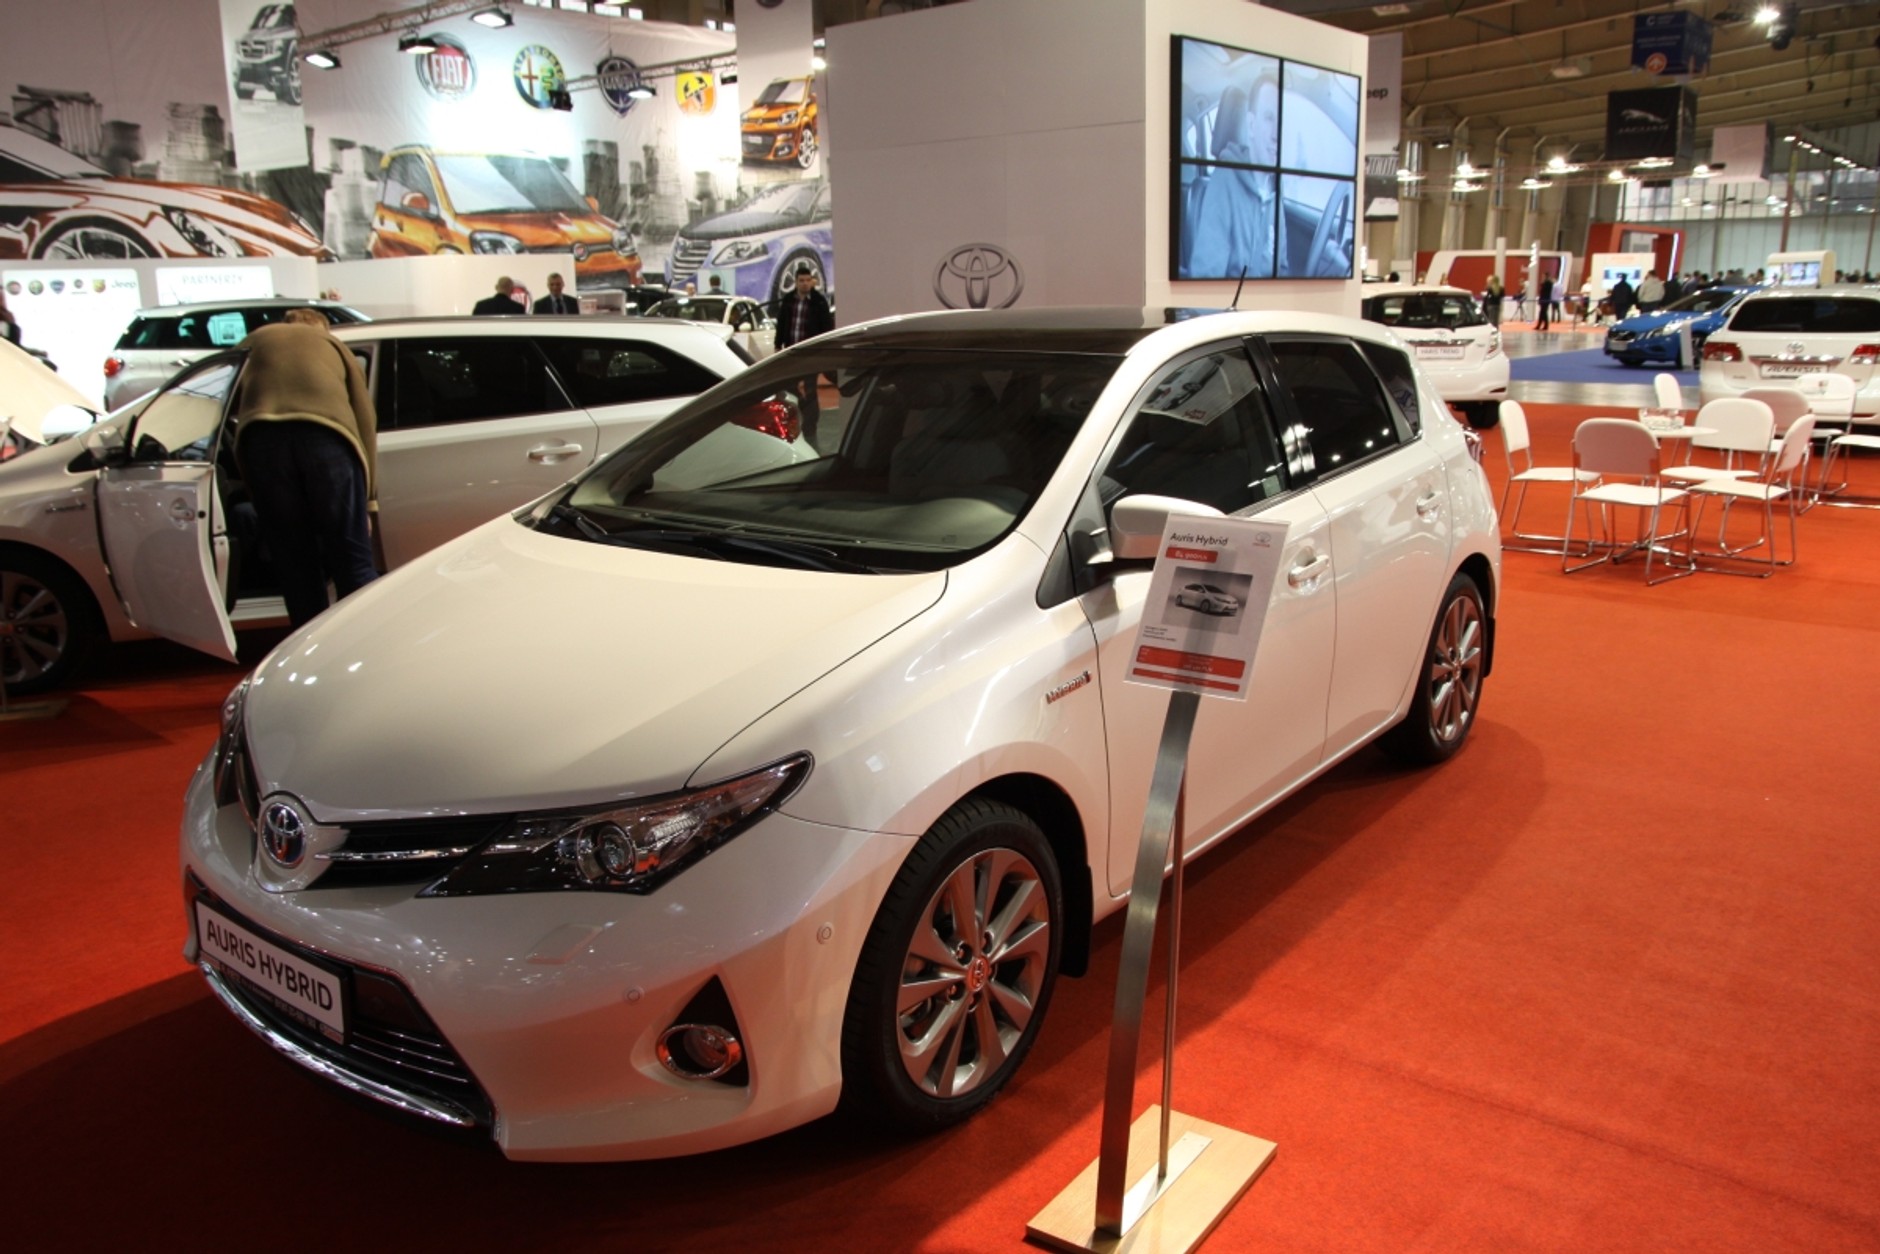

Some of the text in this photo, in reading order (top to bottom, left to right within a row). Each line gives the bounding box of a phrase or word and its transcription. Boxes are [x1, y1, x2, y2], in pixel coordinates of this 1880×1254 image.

[431, 54, 464, 87] FIAT
[1170, 532, 1229, 546] Auris Hybrid
[206, 919, 256, 969] AURIS
[258, 949, 333, 1011] HYBRID
